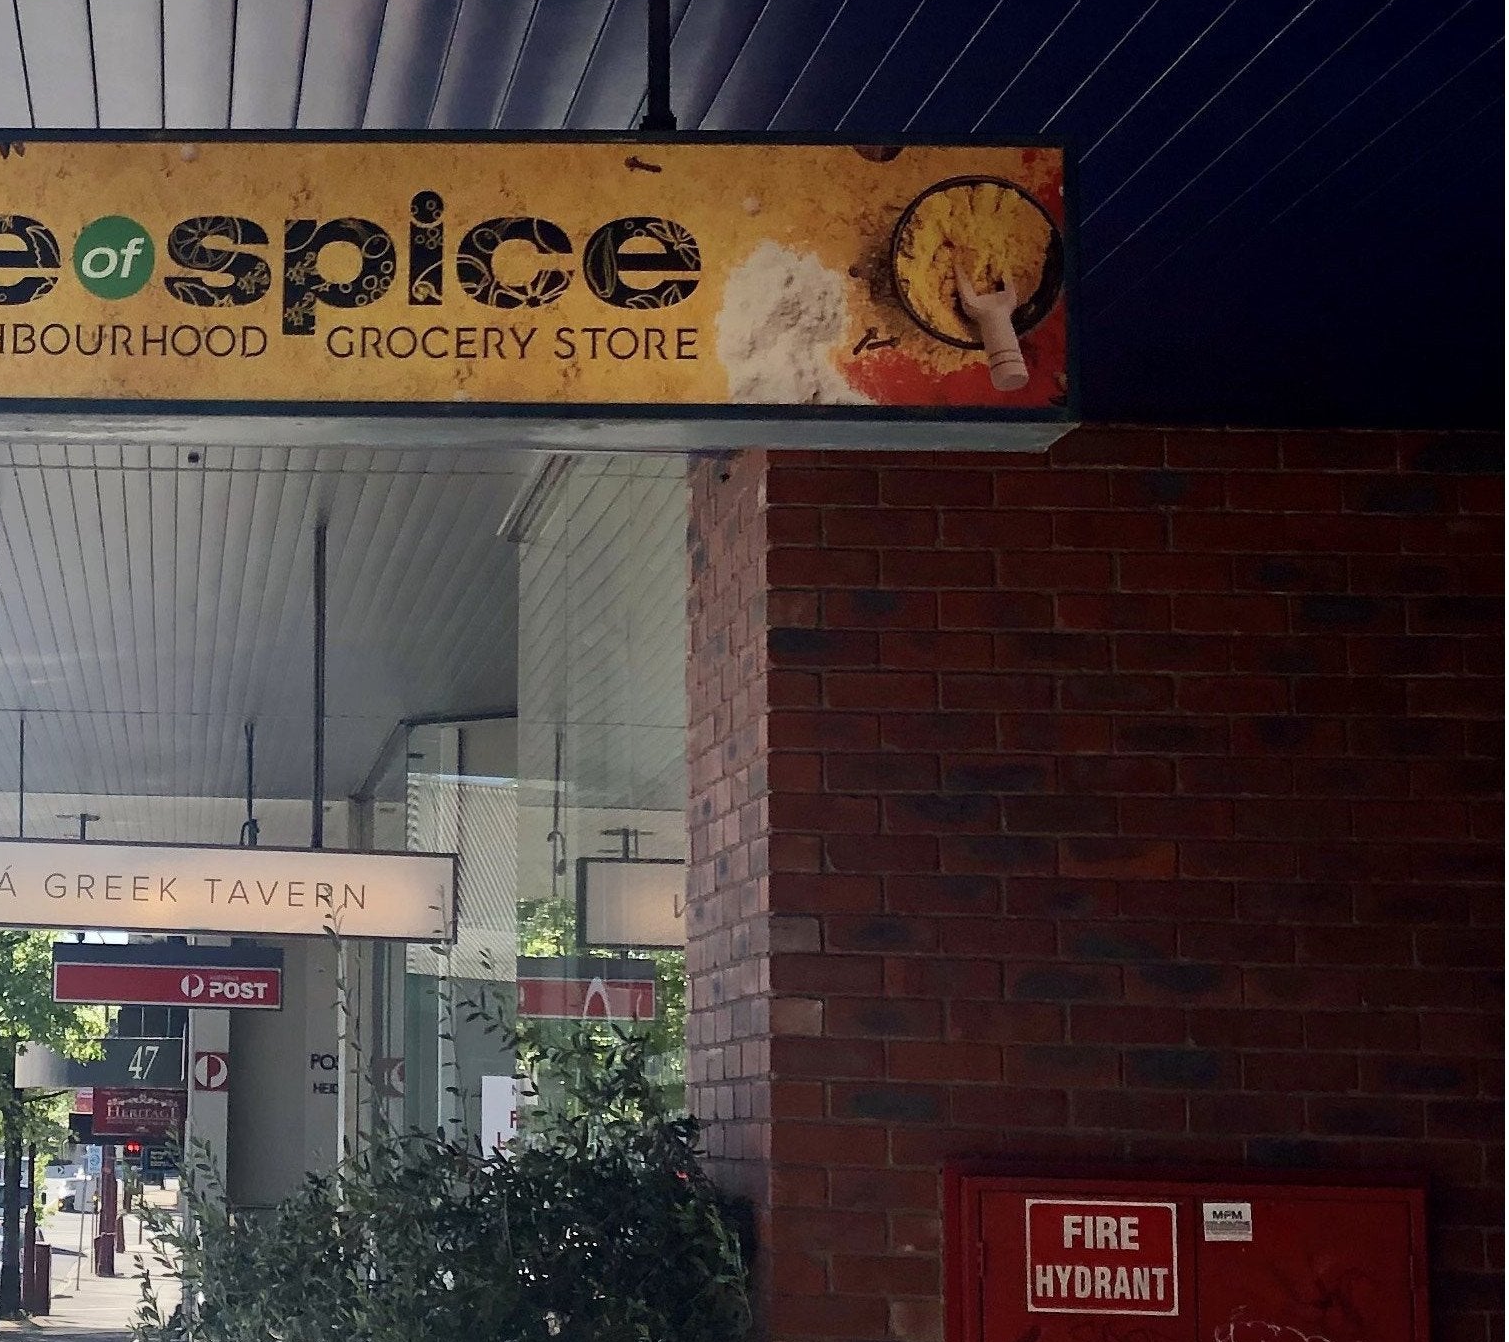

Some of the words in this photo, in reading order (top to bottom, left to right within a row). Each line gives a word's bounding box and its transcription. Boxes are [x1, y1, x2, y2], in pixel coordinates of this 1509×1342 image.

[81, 238, 146, 281] of
[162, 189, 703, 336] spice
[326, 324, 531, 362] GROCERY
[553, 326, 699, 362] STORE
[43, 872, 178, 903] GREEK
[203, 877, 366, 910] TAVERN
[208, 981, 269, 1000] POST
[128, 1045, 160, 1080] 47
[310, 1054, 339, 1070] PO
[1063, 1215, 1140, 1250] FIRE
[1035, 1264, 1169, 1301] HYDRANT
